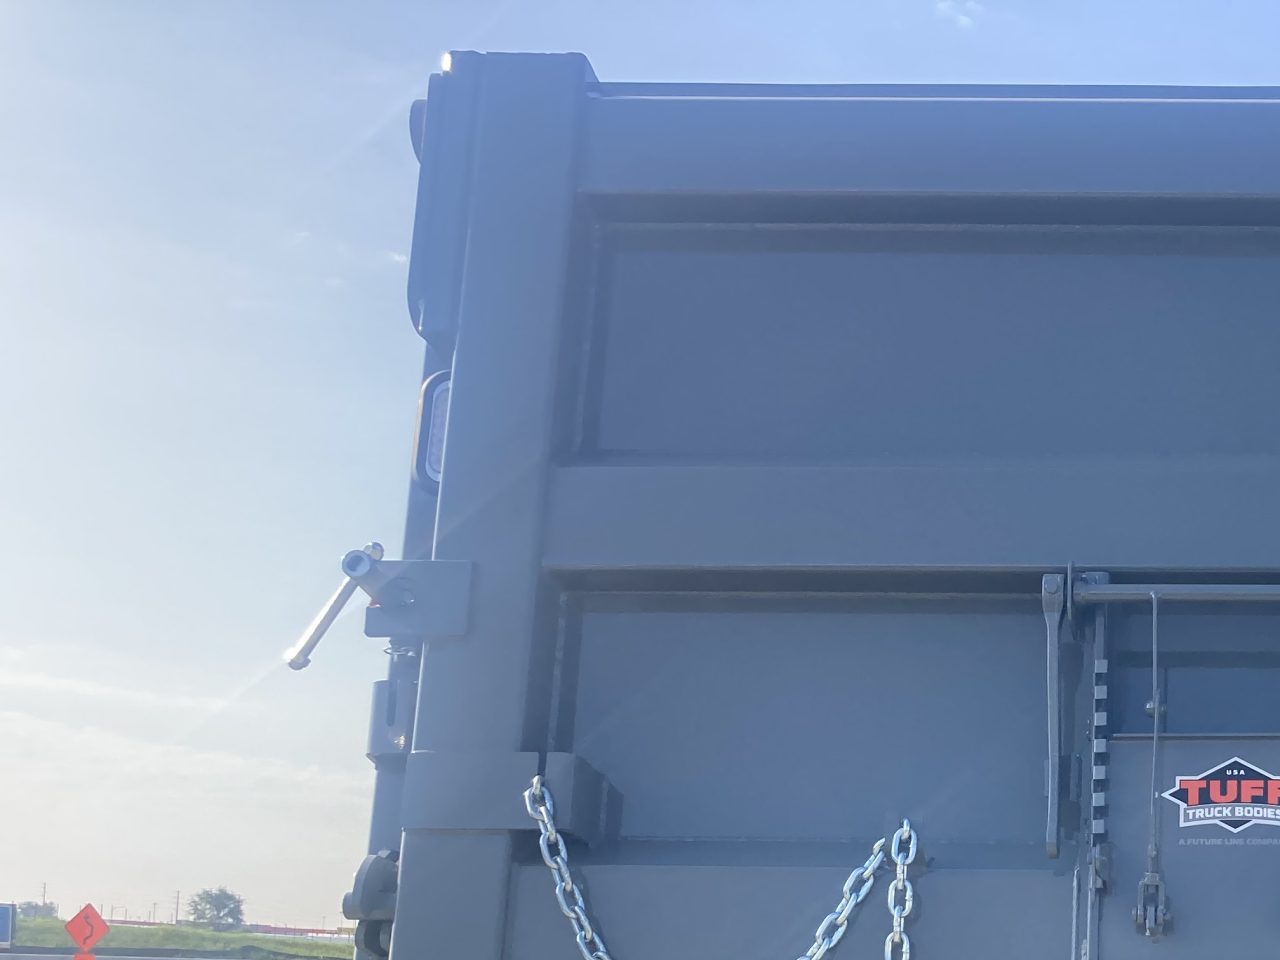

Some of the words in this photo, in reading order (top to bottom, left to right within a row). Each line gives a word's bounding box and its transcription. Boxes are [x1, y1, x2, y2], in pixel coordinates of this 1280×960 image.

[1186, 806, 1232, 820] TRUCK
[1178, 838, 1186, 846] A
[1187, 838, 1222, 846] FUTURE
[1224, 838, 1244, 846] LINE
